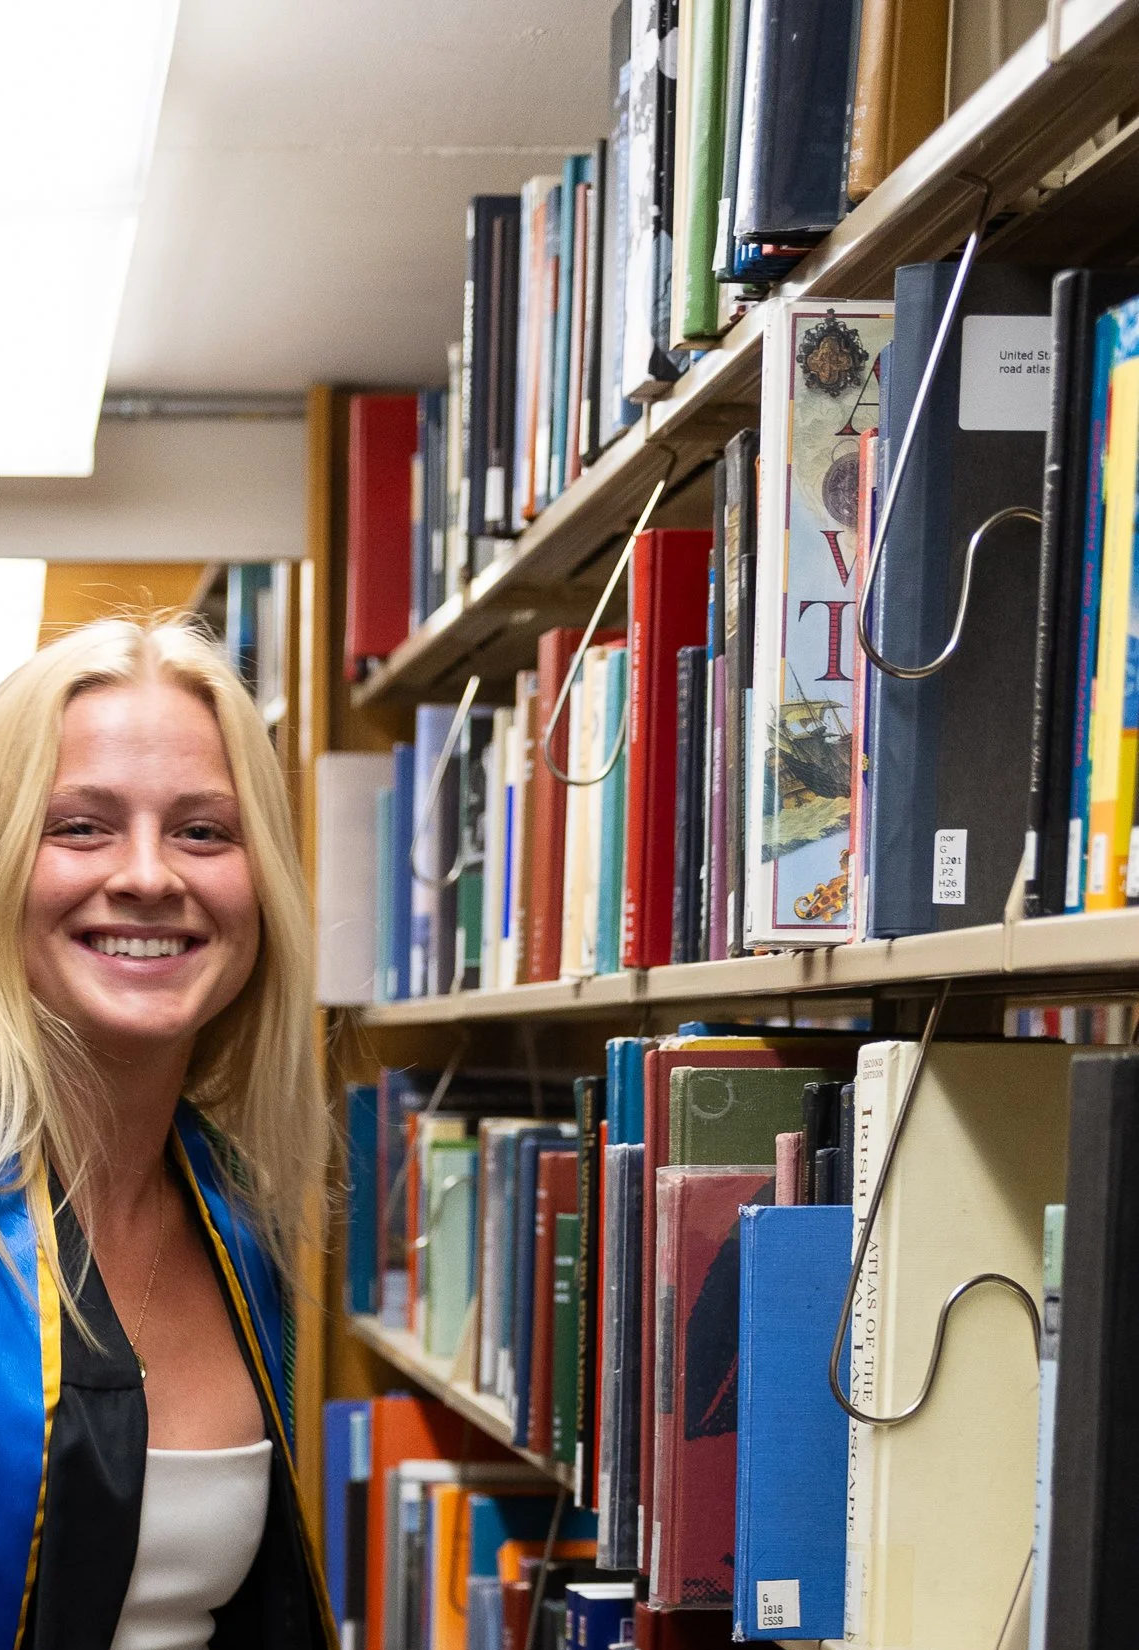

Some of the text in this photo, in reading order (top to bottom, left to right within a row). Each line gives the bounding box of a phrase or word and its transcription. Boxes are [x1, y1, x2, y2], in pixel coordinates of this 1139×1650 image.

[1000, 350, 1033, 360] United
[999, 363, 1050, 373] road atlas
[939, 845, 947, 854] G
[940, 857, 962, 865] 1201
[939, 868, 954, 877] .P2
[938, 879, 958, 888] H26
[939, 890, 962, 899] 1993
[863, 1058, 883, 1069] SECOND
[863, 1069, 884, 1081] EDITION
[859, 1105, 872, 1198] IRISH
[853, 1217, 867, 1329] RRAL
[863, 1239, 879, 1403] ATLAS OF THE
[762, 1593, 769, 1603] G
[763, 1605, 783, 1615] 1818
